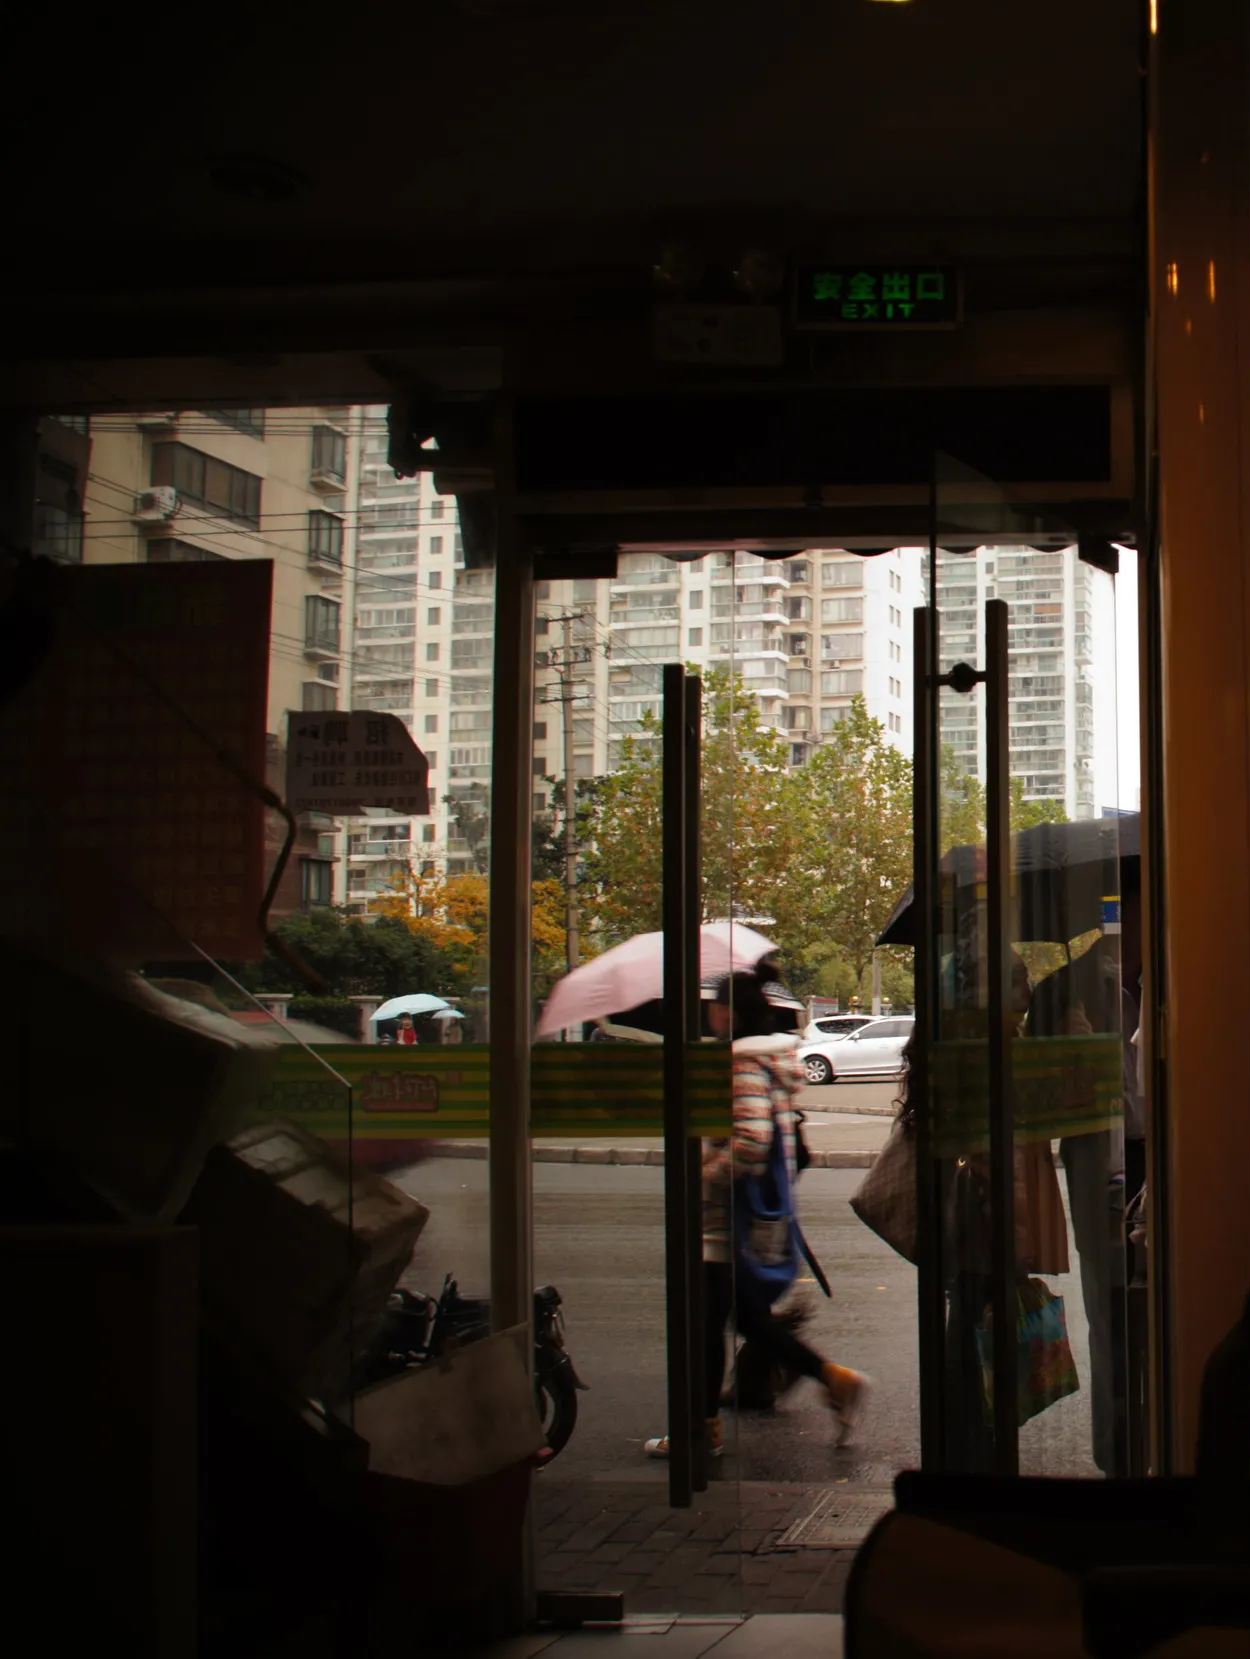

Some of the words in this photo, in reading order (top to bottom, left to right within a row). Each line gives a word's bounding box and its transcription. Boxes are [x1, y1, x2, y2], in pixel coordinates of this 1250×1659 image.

[813, 271, 945, 301] 安全出口
[840, 302, 916, 320] EXIT
